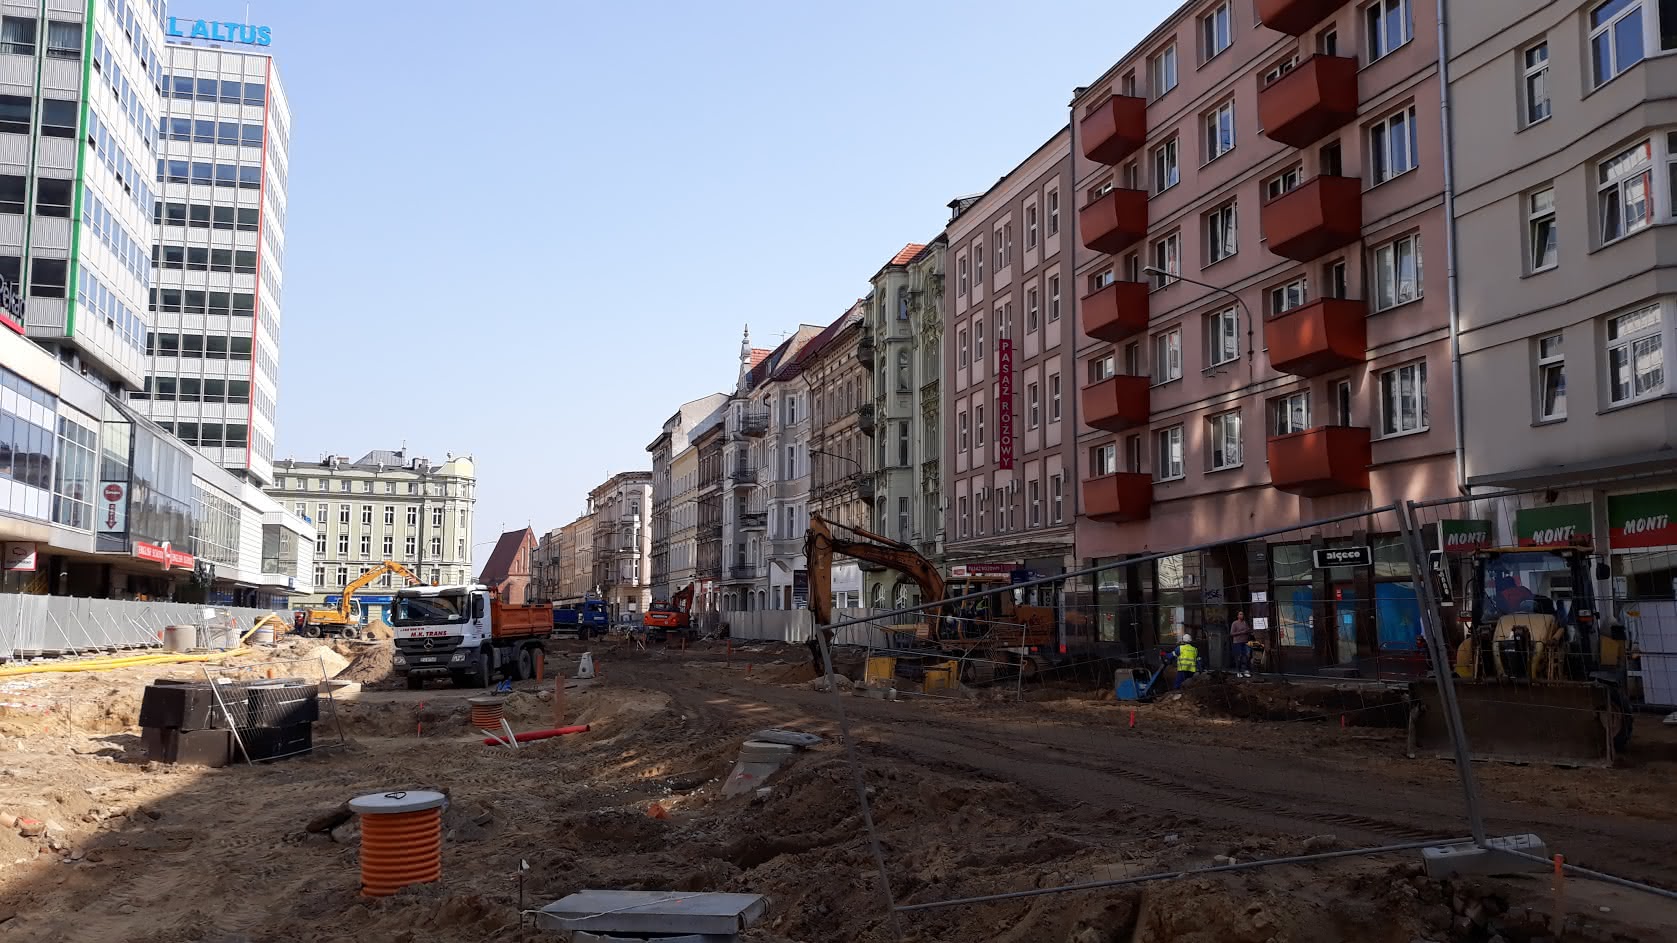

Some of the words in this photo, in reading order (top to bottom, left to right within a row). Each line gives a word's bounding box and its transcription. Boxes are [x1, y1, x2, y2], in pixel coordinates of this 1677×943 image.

[191, 19, 272, 46] ALTUS
[1002, 342, 1010, 396] PASAŻ
[1001, 401, 1011, 466] RÓŻOWY
